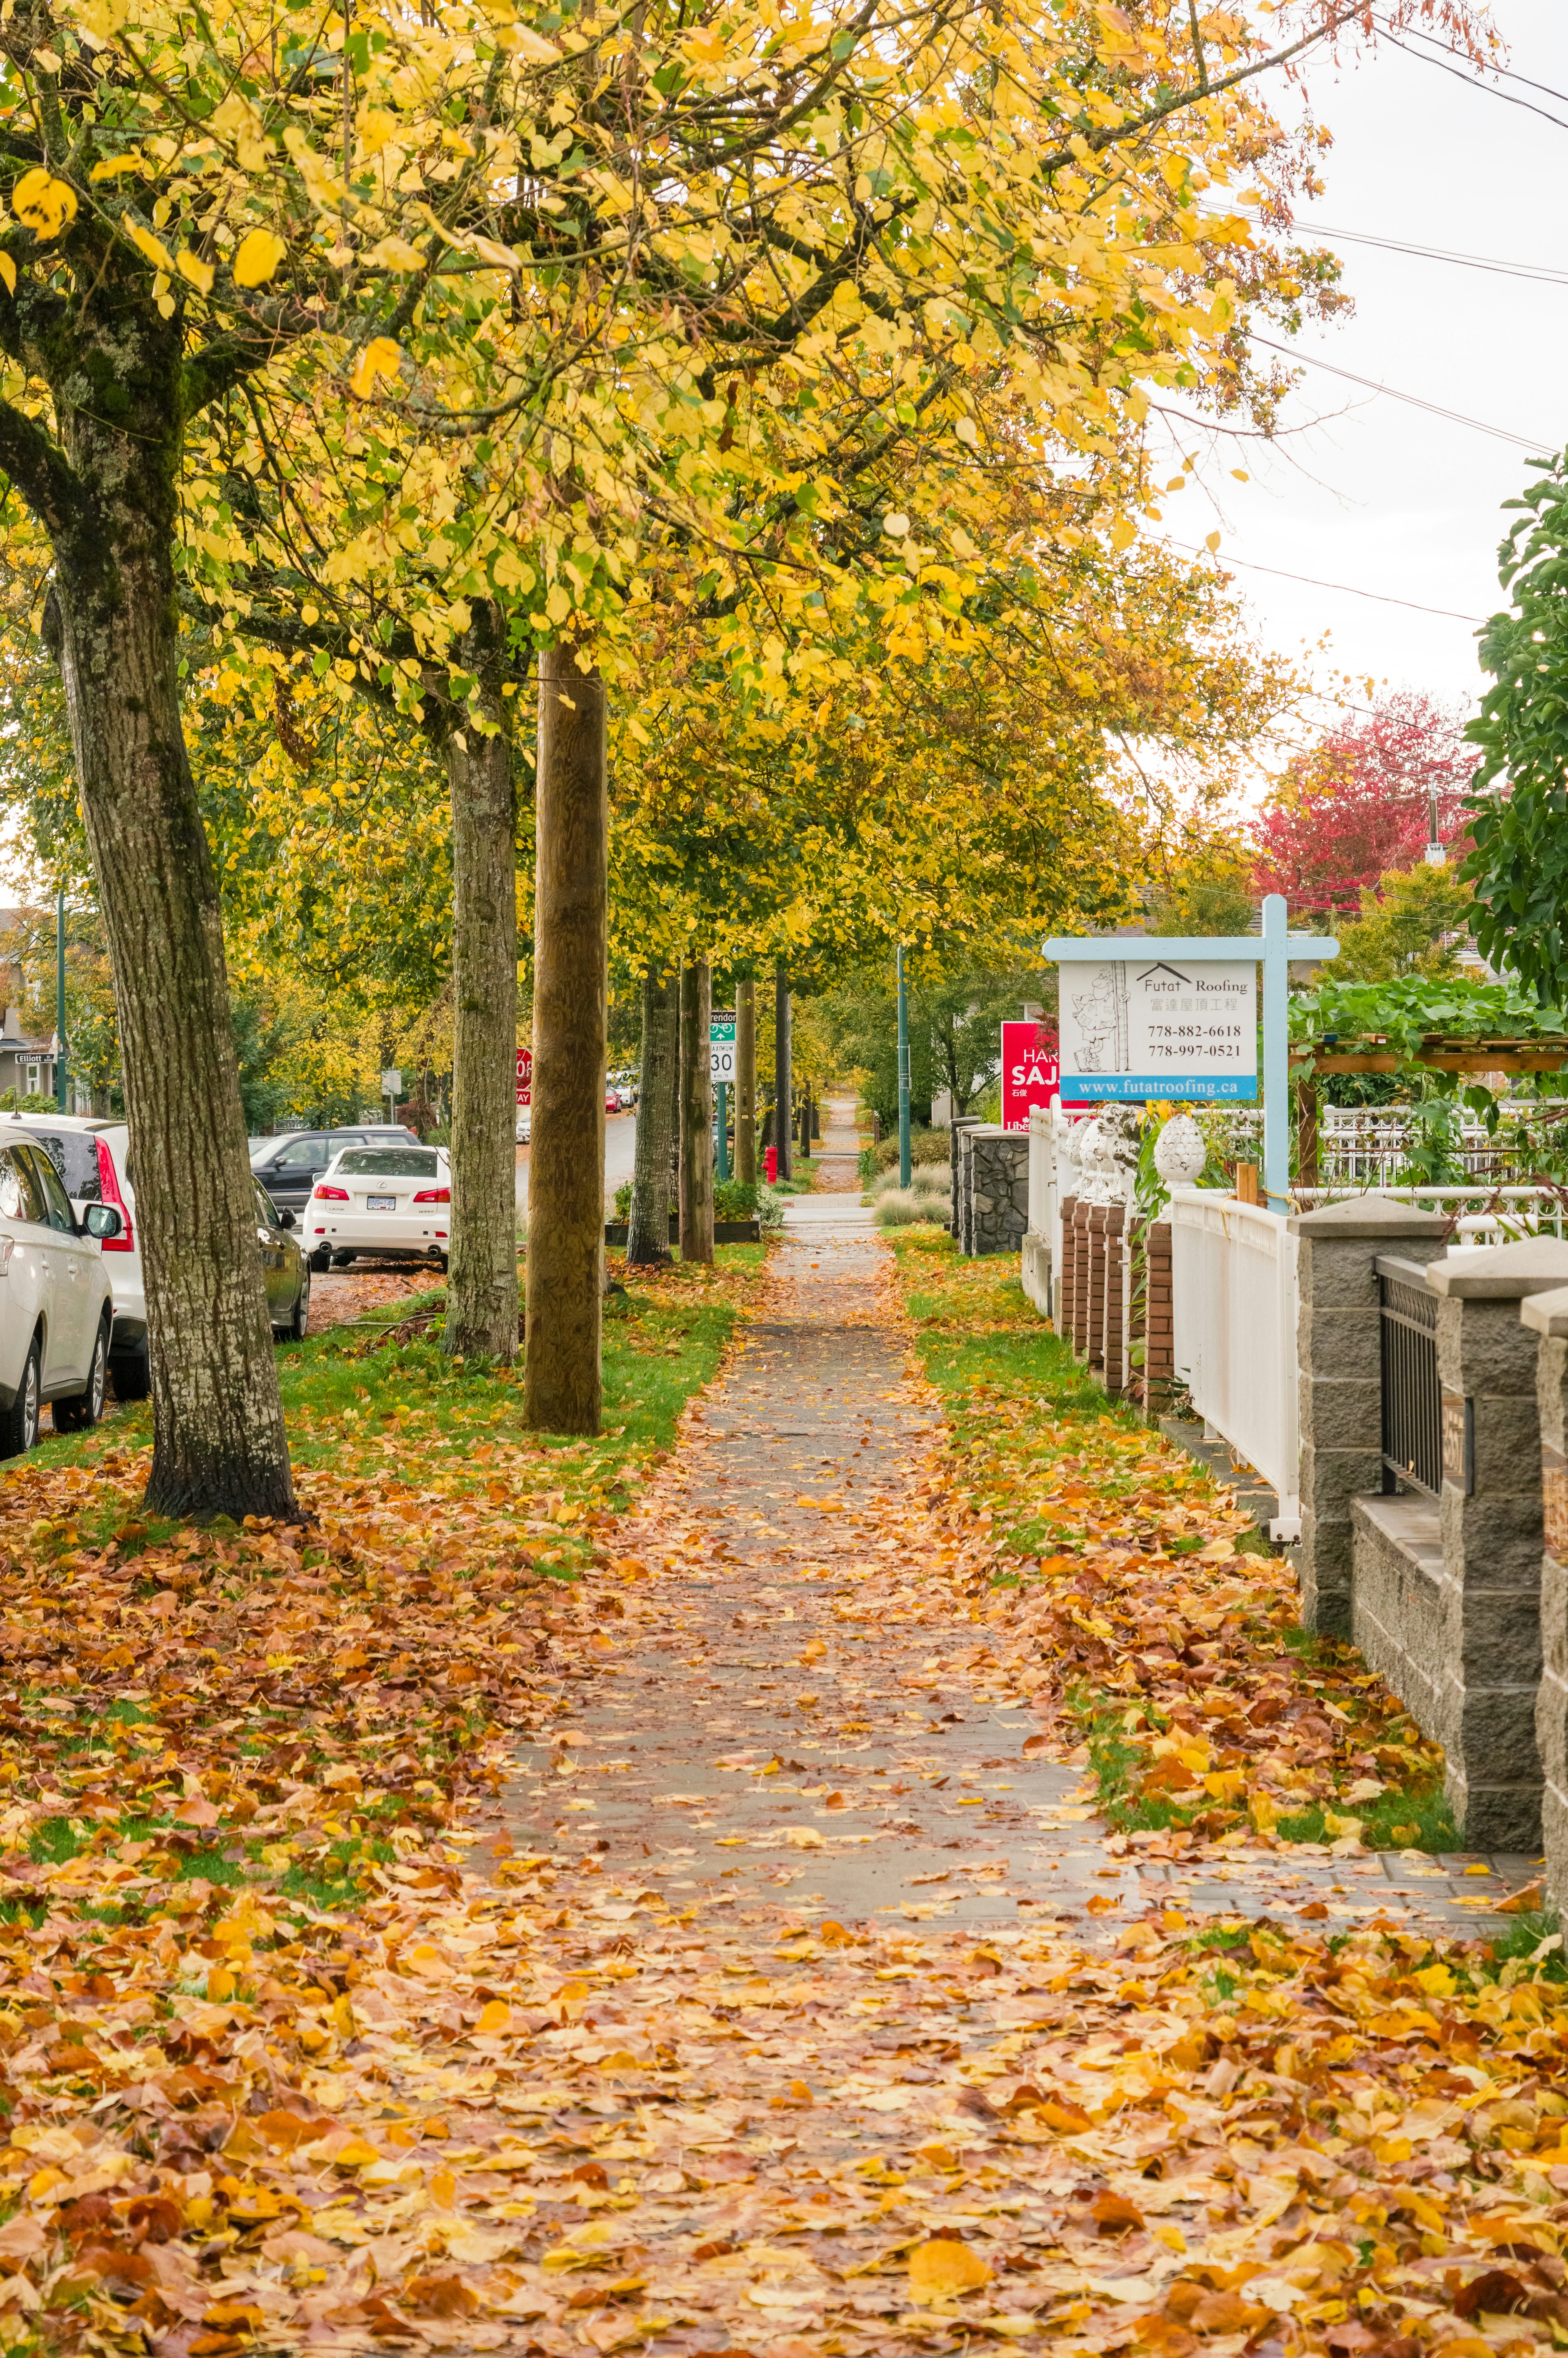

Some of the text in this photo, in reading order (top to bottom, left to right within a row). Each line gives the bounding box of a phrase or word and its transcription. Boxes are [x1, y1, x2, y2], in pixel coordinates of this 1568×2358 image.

[1145, 979, 1248, 995] Futat Roofing
[1150, 998, 1238, 1011] 富達屋頂工程
[1148, 1025, 1241, 1037] 778-882-6618
[1023, 1049, 1060, 1063] HAR
[1149, 1045, 1240, 1057] 778-997-0521
[711, 1054, 732, 1071] 30
[1011, 1065, 1060, 1085] SAJ
[1079, 1079, 1238, 1096] www.futatroofing.ca
[517, 1094, 529, 1102] AY
